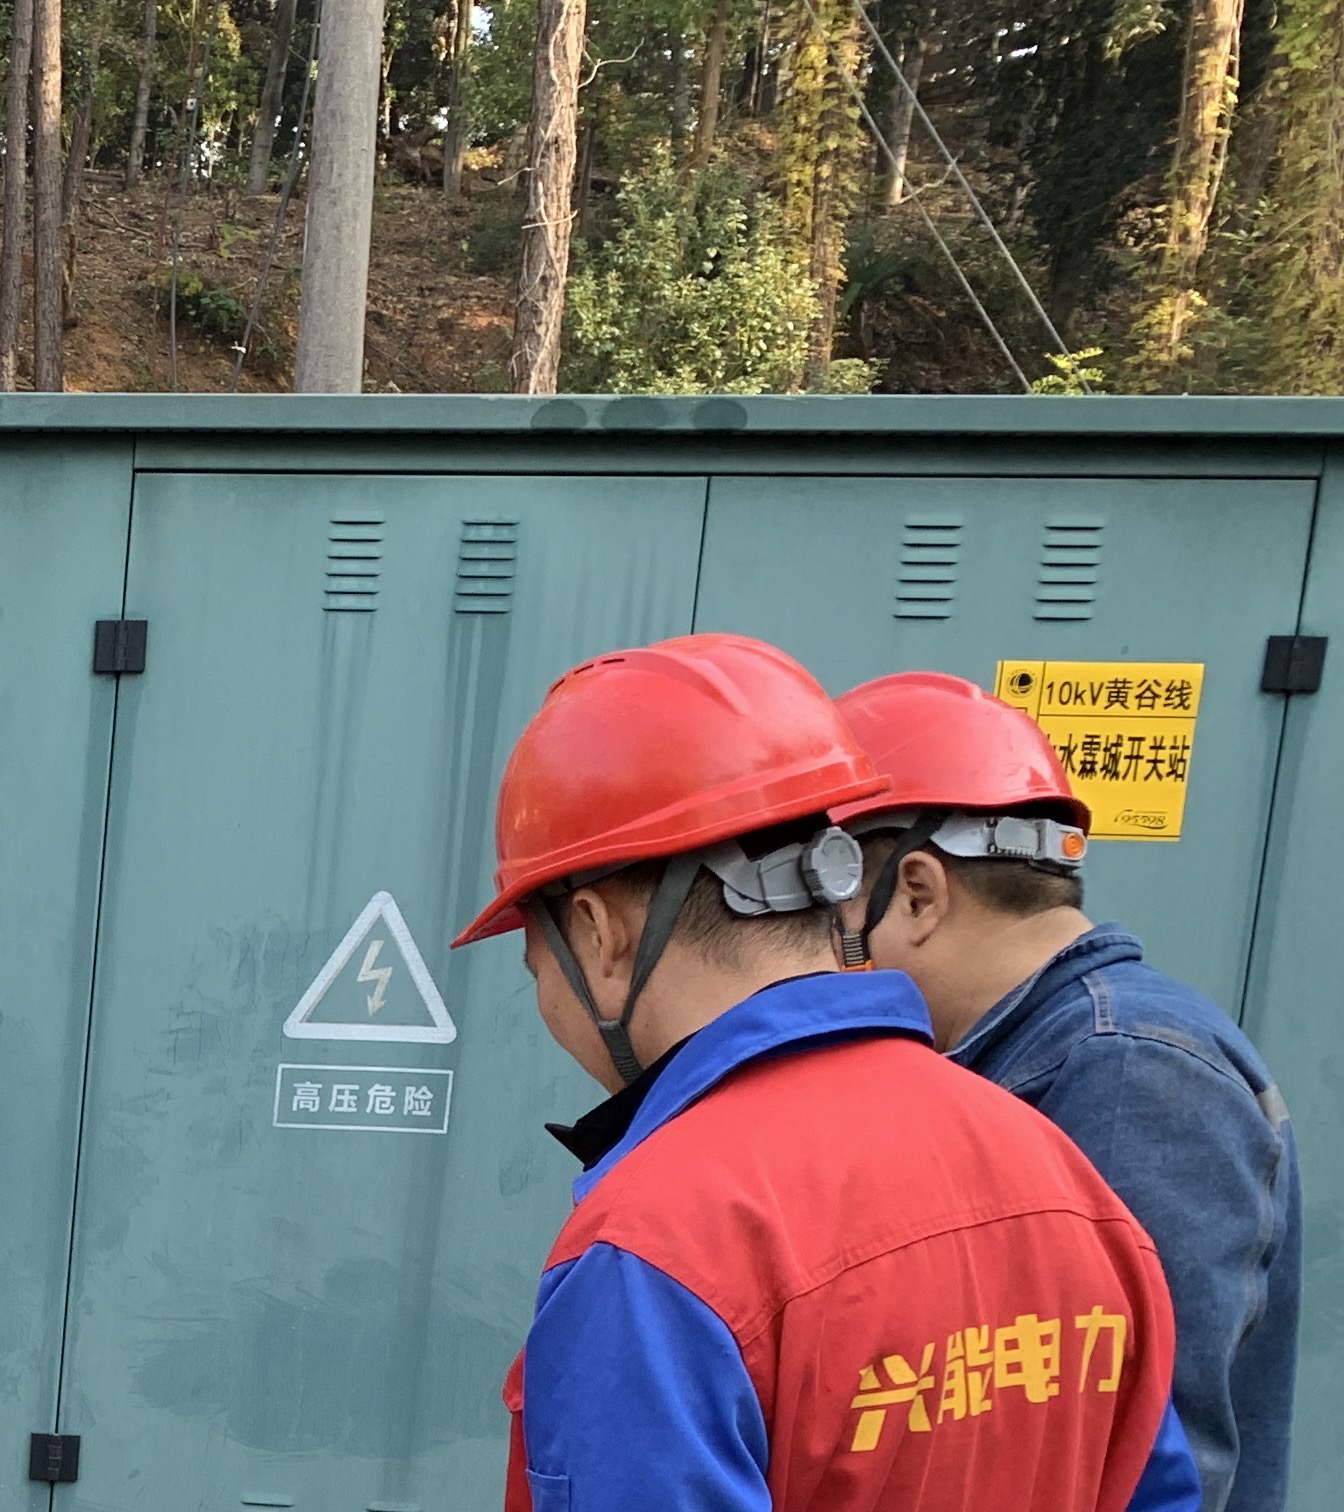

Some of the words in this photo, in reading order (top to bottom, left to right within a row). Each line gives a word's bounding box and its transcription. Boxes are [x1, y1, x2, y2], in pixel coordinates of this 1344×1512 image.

[1045, 678, 1193, 711] 10kV黄谷线
[1047, 733, 1190, 782] 水霖城开关站
[292, 1081, 434, 1116] 高压危险
[850, 1305, 1126, 1452] 兴能电力
